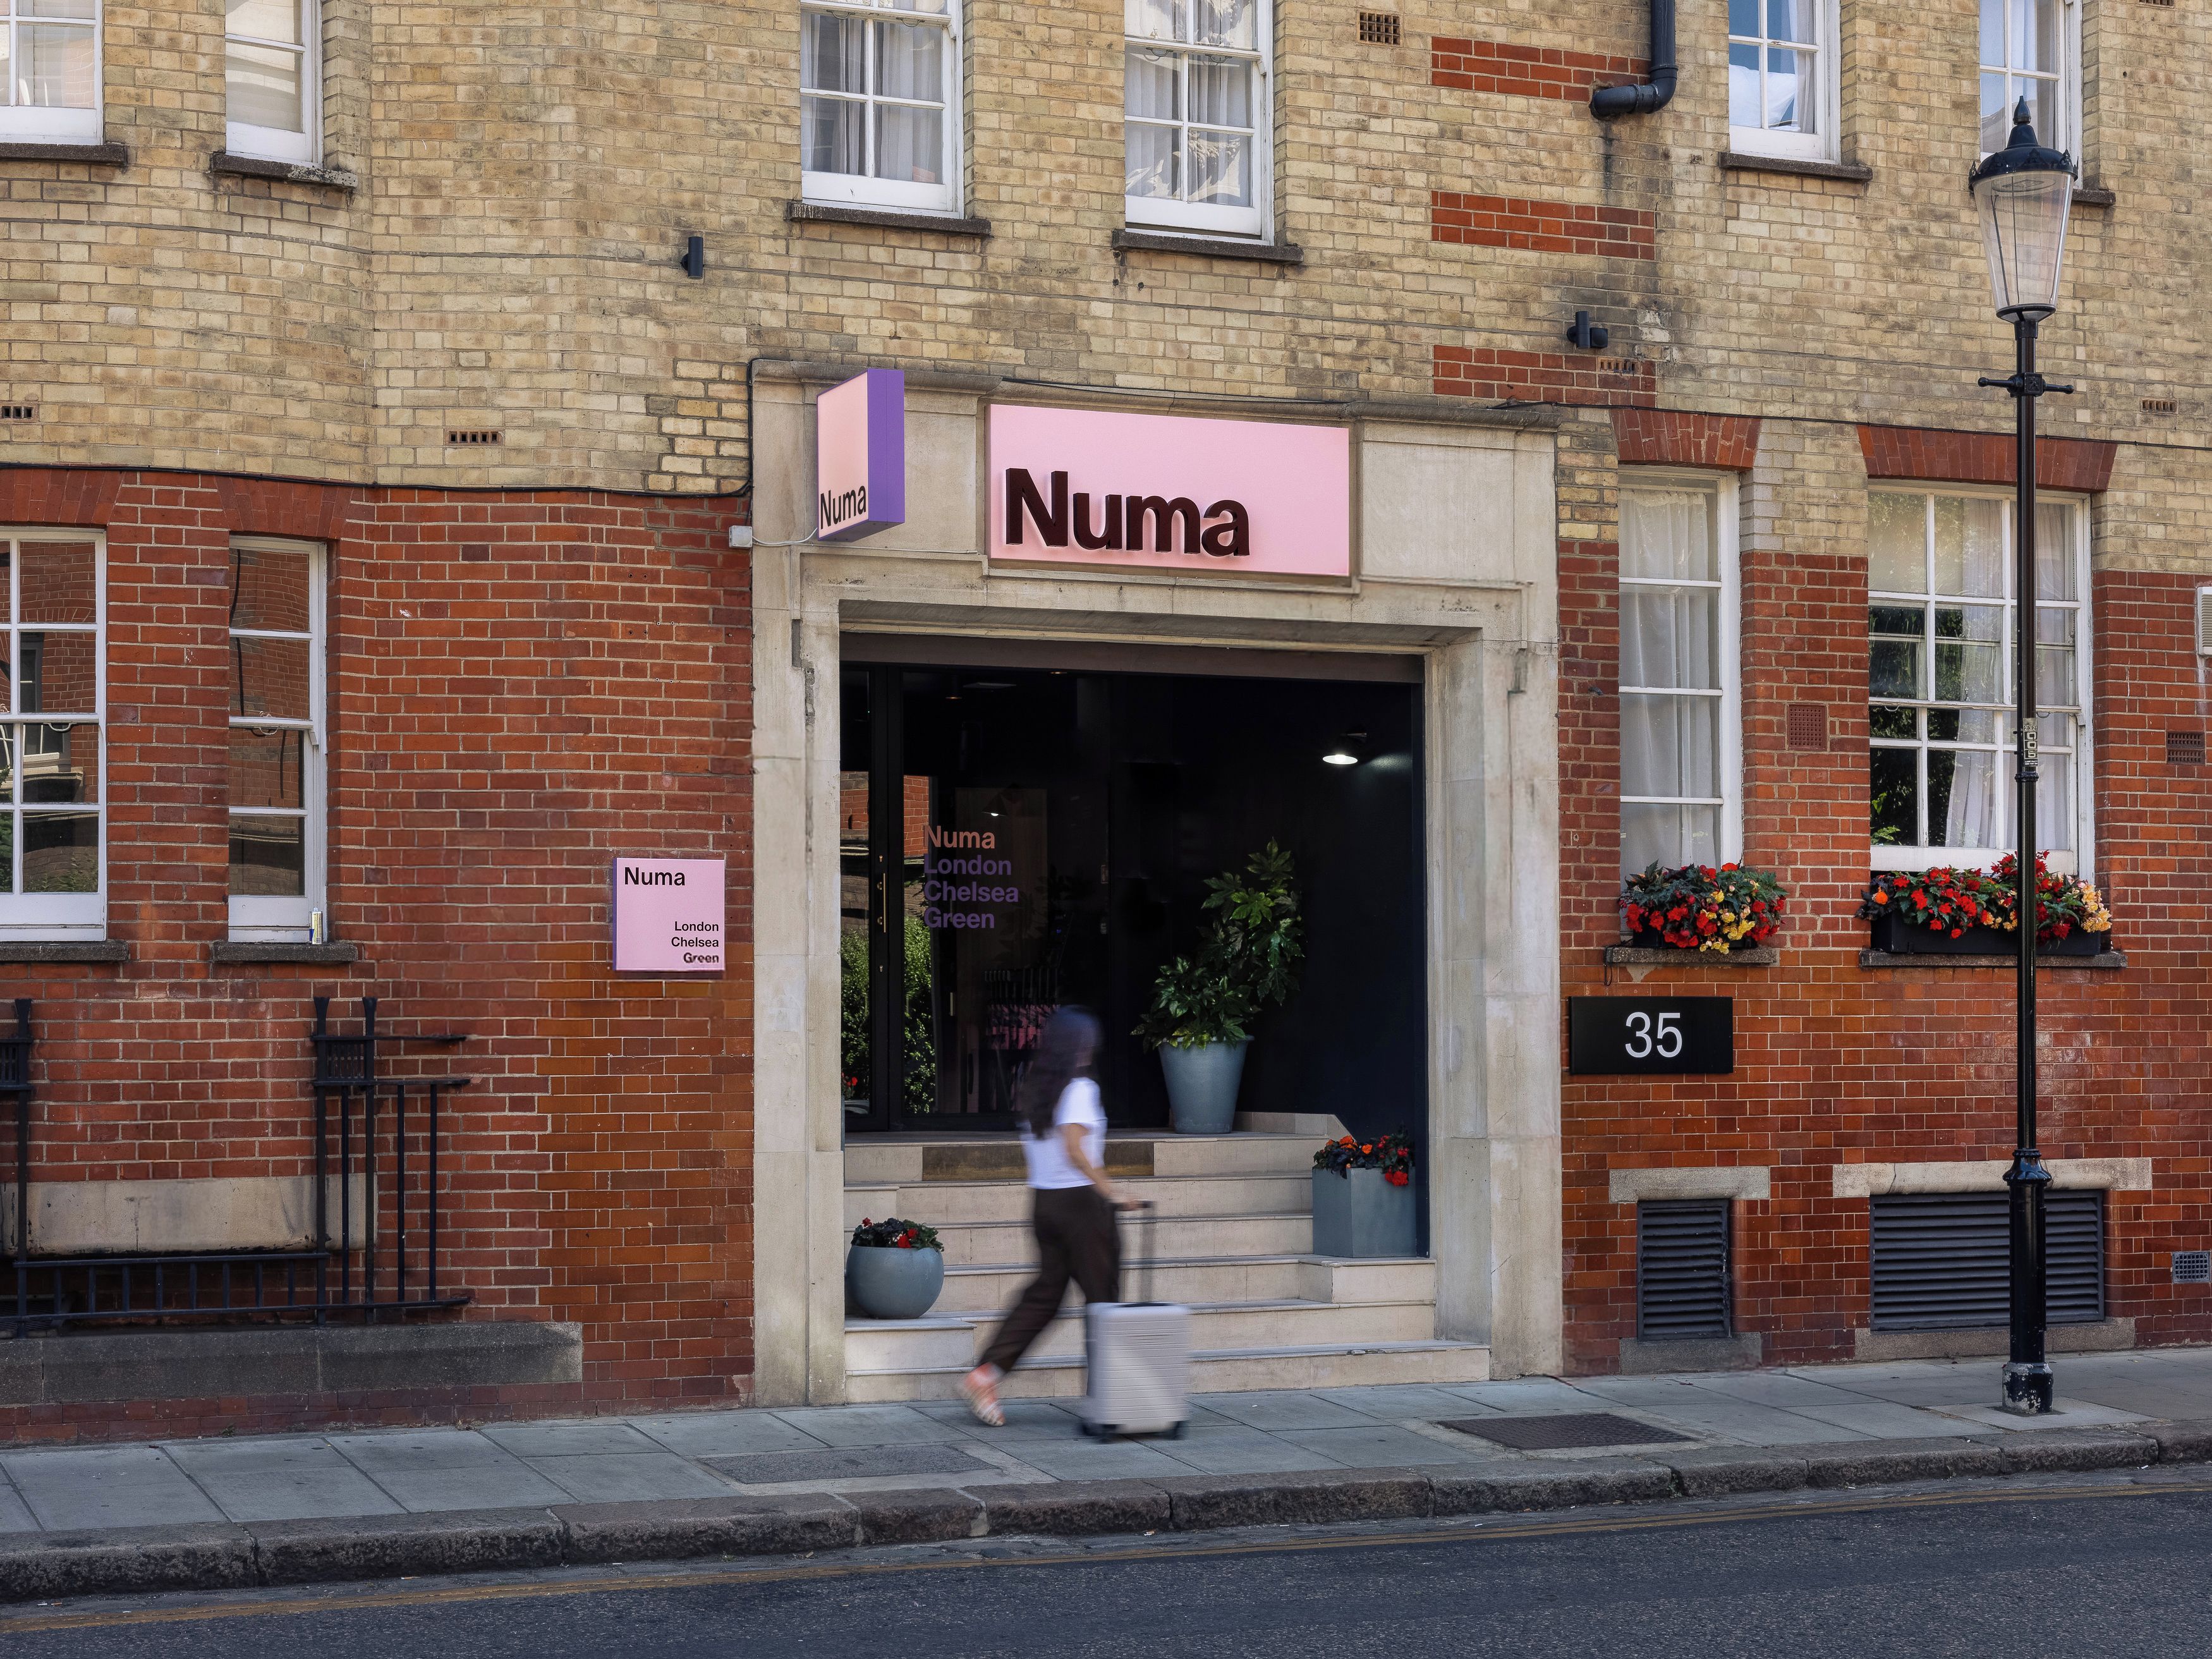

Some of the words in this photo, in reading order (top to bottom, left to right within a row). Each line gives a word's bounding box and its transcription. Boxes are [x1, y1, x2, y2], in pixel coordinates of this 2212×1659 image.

[820, 485, 866, 530] Numa
[1006, 468, 1250, 557] Numa
[924, 824, 995, 849] Numa
[924, 853, 1011, 875] London
[624, 866, 686, 886] Numa
[924, 880, 1019, 902] Chelsea
[674, 921, 719, 932] London
[924, 907, 995, 928] Green
[671, 937, 719, 947] Chelsea
[683, 952, 719, 963] Green
[1625, 1012, 1682, 1058] 35
